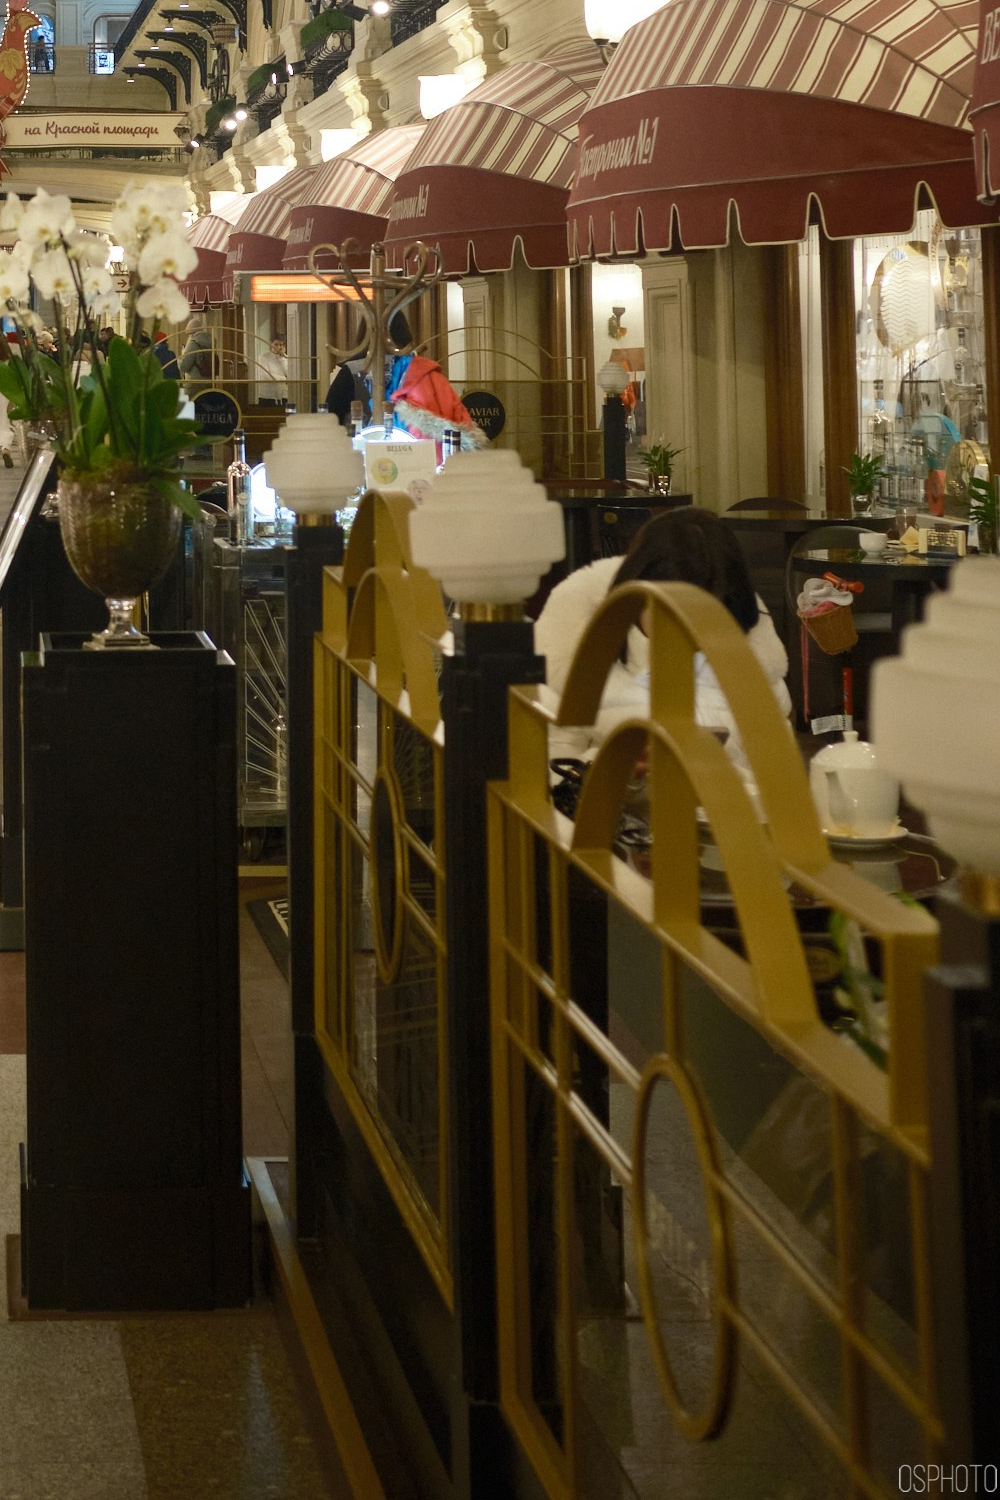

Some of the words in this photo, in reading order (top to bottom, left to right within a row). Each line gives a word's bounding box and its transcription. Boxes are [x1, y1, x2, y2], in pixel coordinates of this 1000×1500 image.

[24, 127, 41, 135] на
[45, 121, 101, 139] Красной
[103, 126, 160, 139] площади
[469, 407, 501, 417] AVIAR
[386, 445, 413, 453] BELUGA
